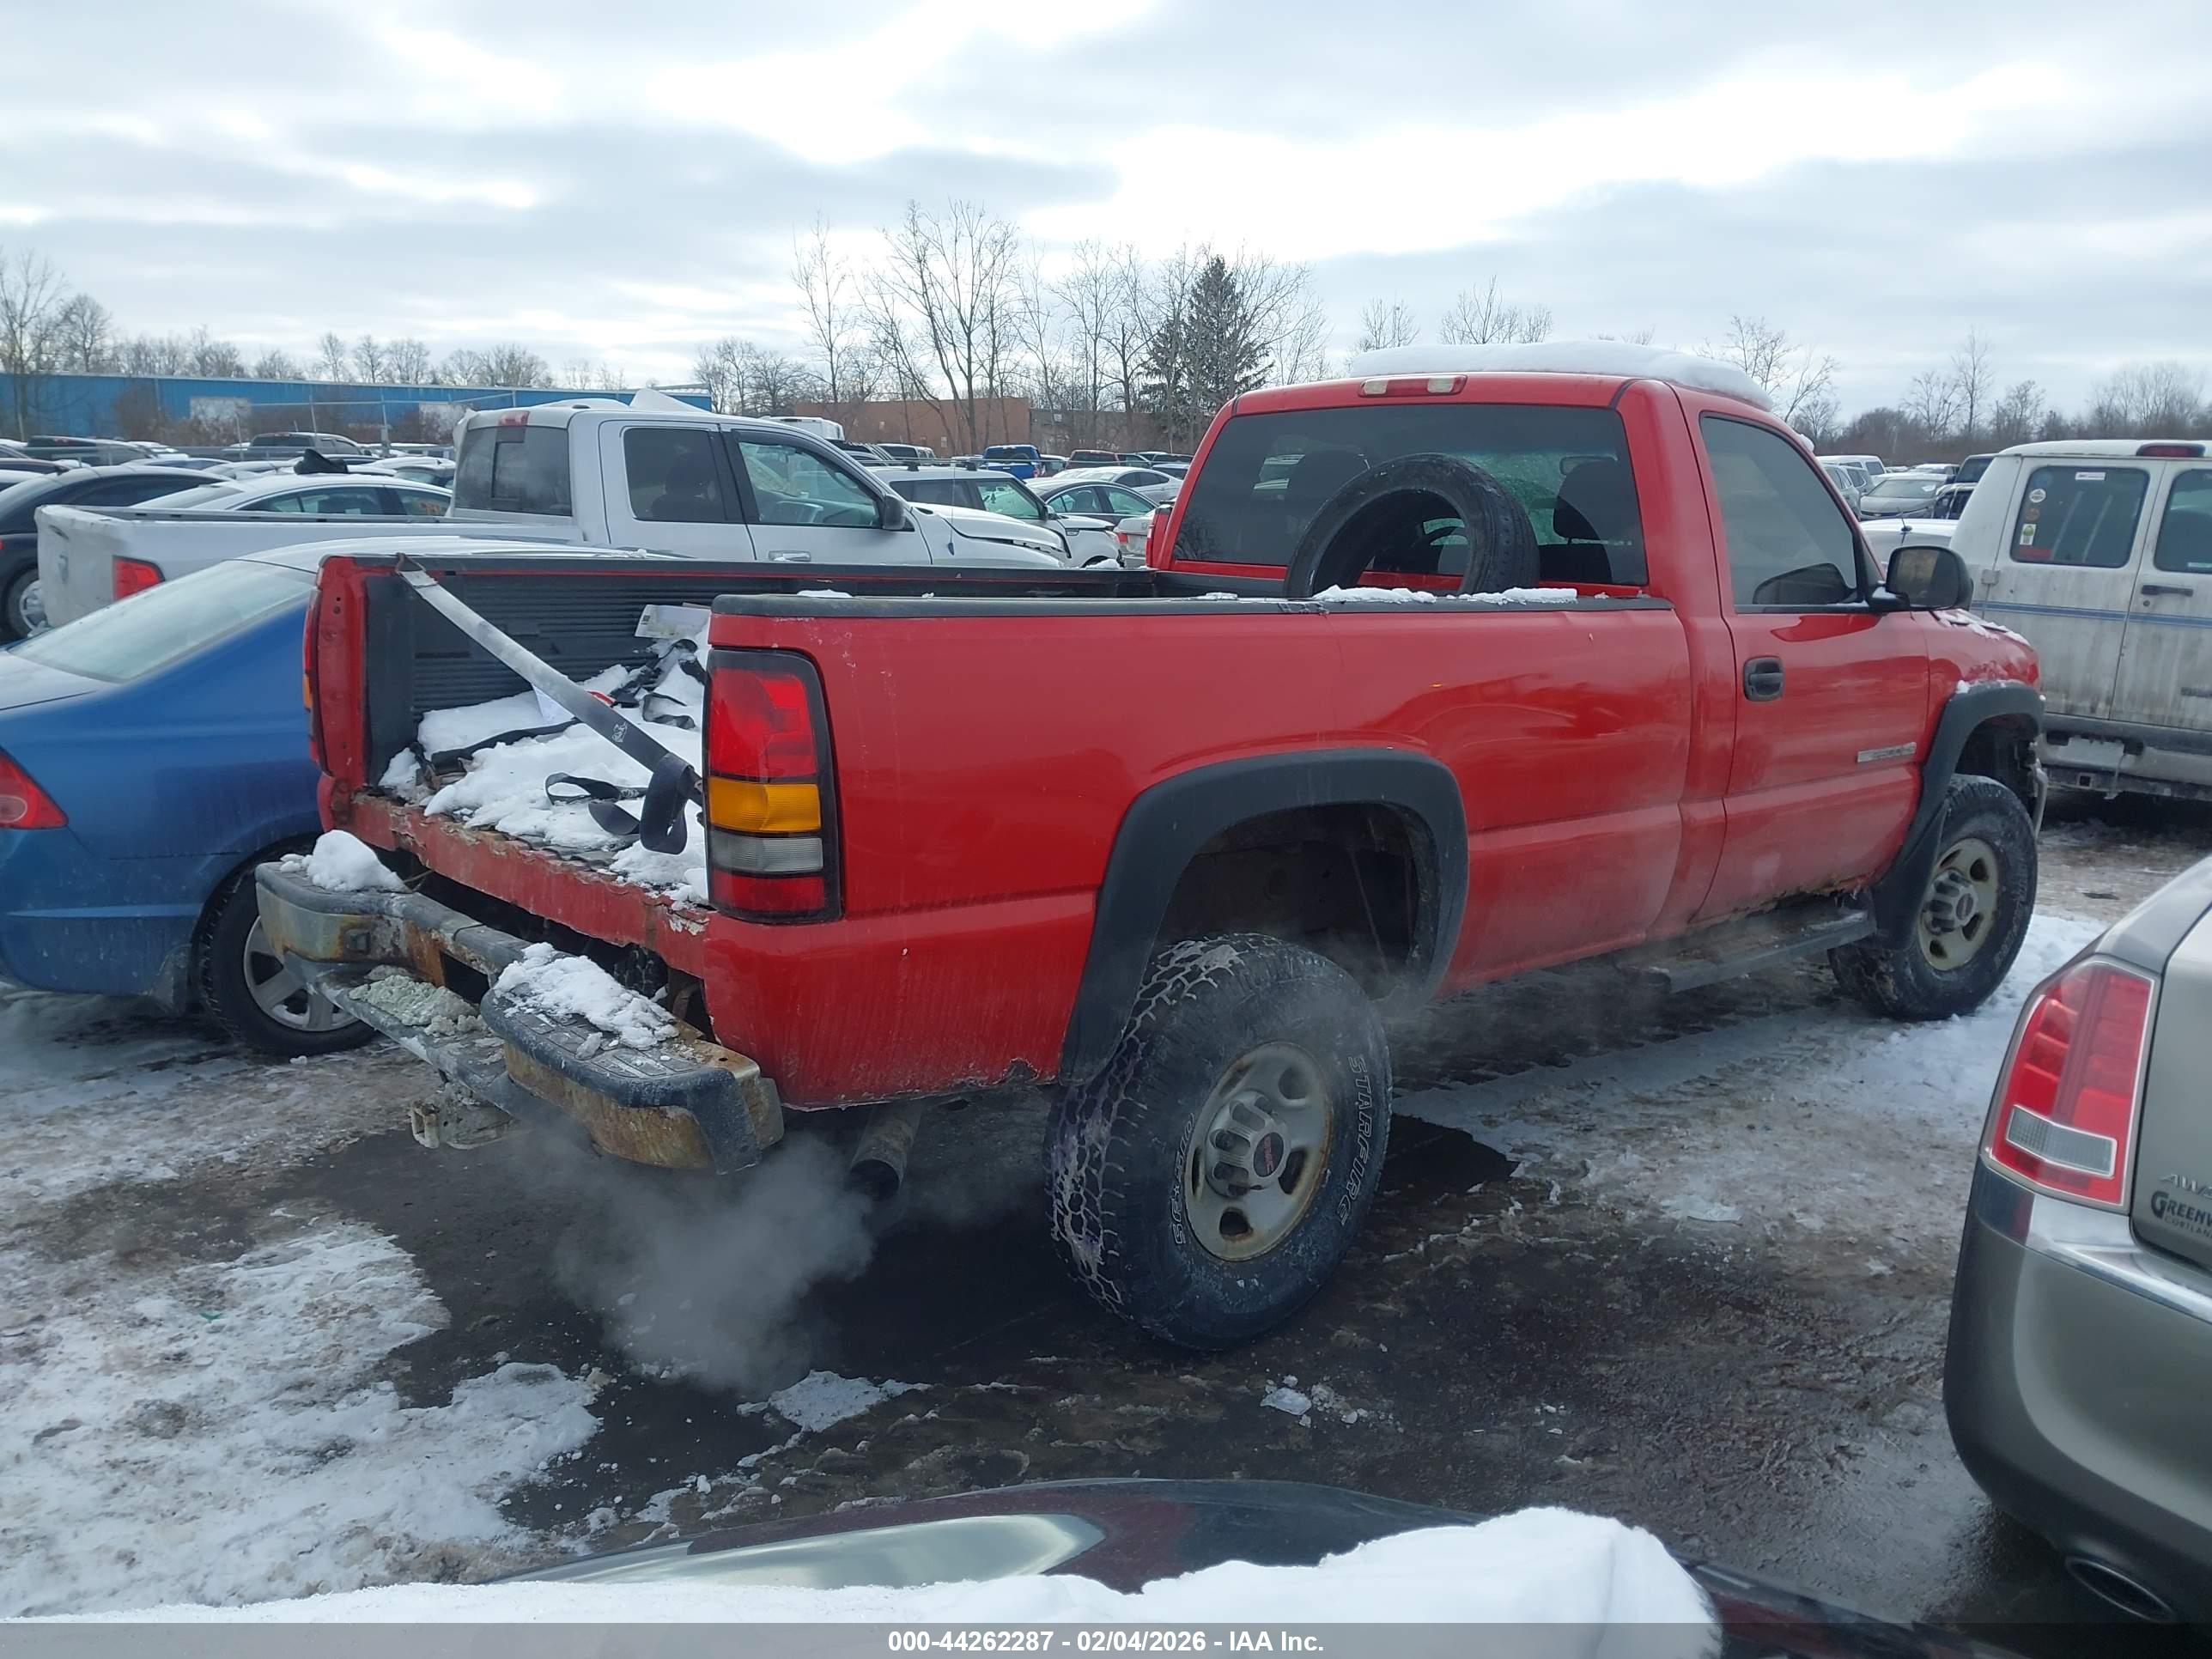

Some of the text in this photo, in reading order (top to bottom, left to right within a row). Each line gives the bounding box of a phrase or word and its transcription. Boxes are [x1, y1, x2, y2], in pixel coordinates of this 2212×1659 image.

[1337, 1055, 1373, 1226] STARFIRE
[2151, 1190, 2212, 1228] GREEN
[2164, 1215, 2212, 1239] CORTLAN
